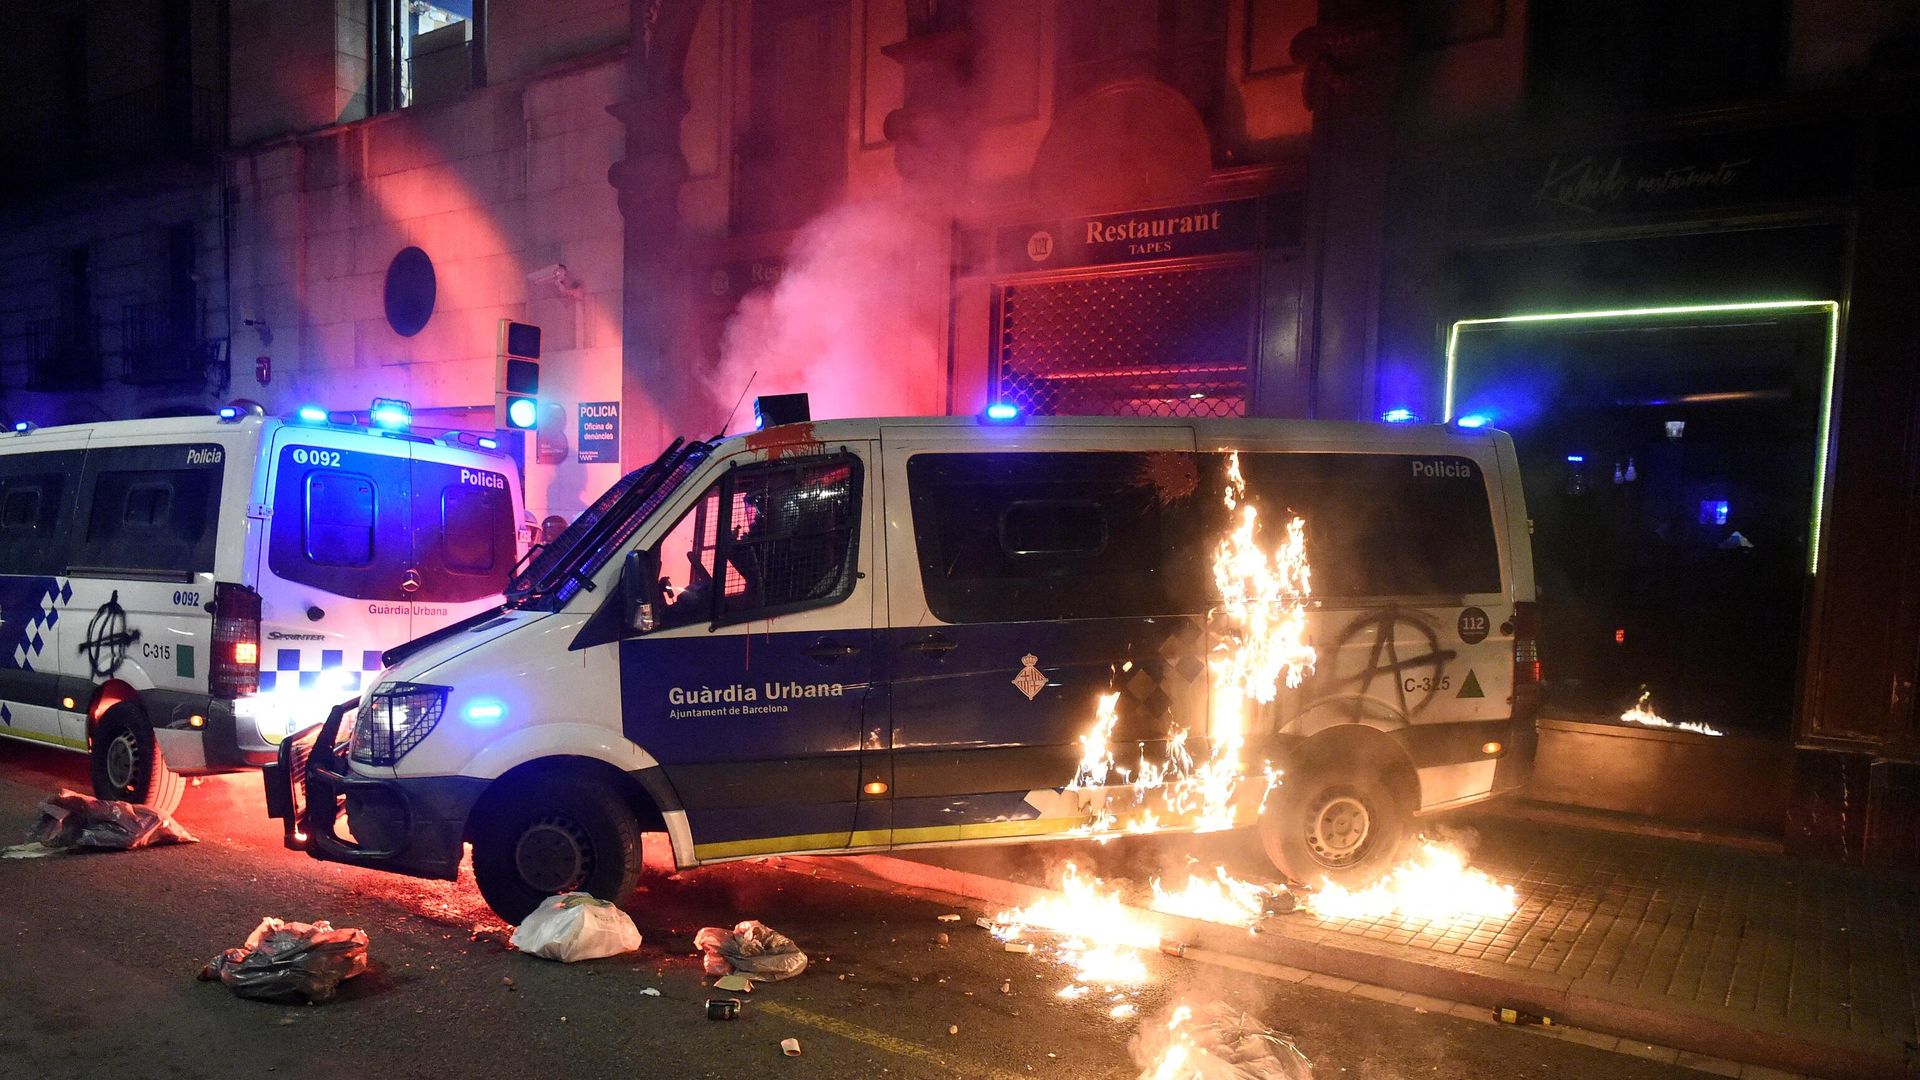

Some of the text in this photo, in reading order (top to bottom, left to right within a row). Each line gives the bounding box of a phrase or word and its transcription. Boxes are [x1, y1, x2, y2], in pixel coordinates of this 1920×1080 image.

[1086, 208, 1221, 244] Restaurant
[1129, 241, 1172, 256] TAPES
[580, 406, 617, 417] POLICIA
[584, 422, 613, 431] Oficina de
[187, 448, 222, 465] Policia
[309, 450, 341, 467] 092
[1412, 461, 1470, 478] Policia
[461, 469, 504, 489] Policia
[181, 591, 199, 607] 092
[368, 603, 448, 617] Guàrdia Urbana
[1463, 617, 1485, 630] 112
[143, 643, 170, 660] C-315
[668, 682, 843, 705] Guàrdia Urbana
[670, 704, 788, 720] Ajuntament de Barcelona
